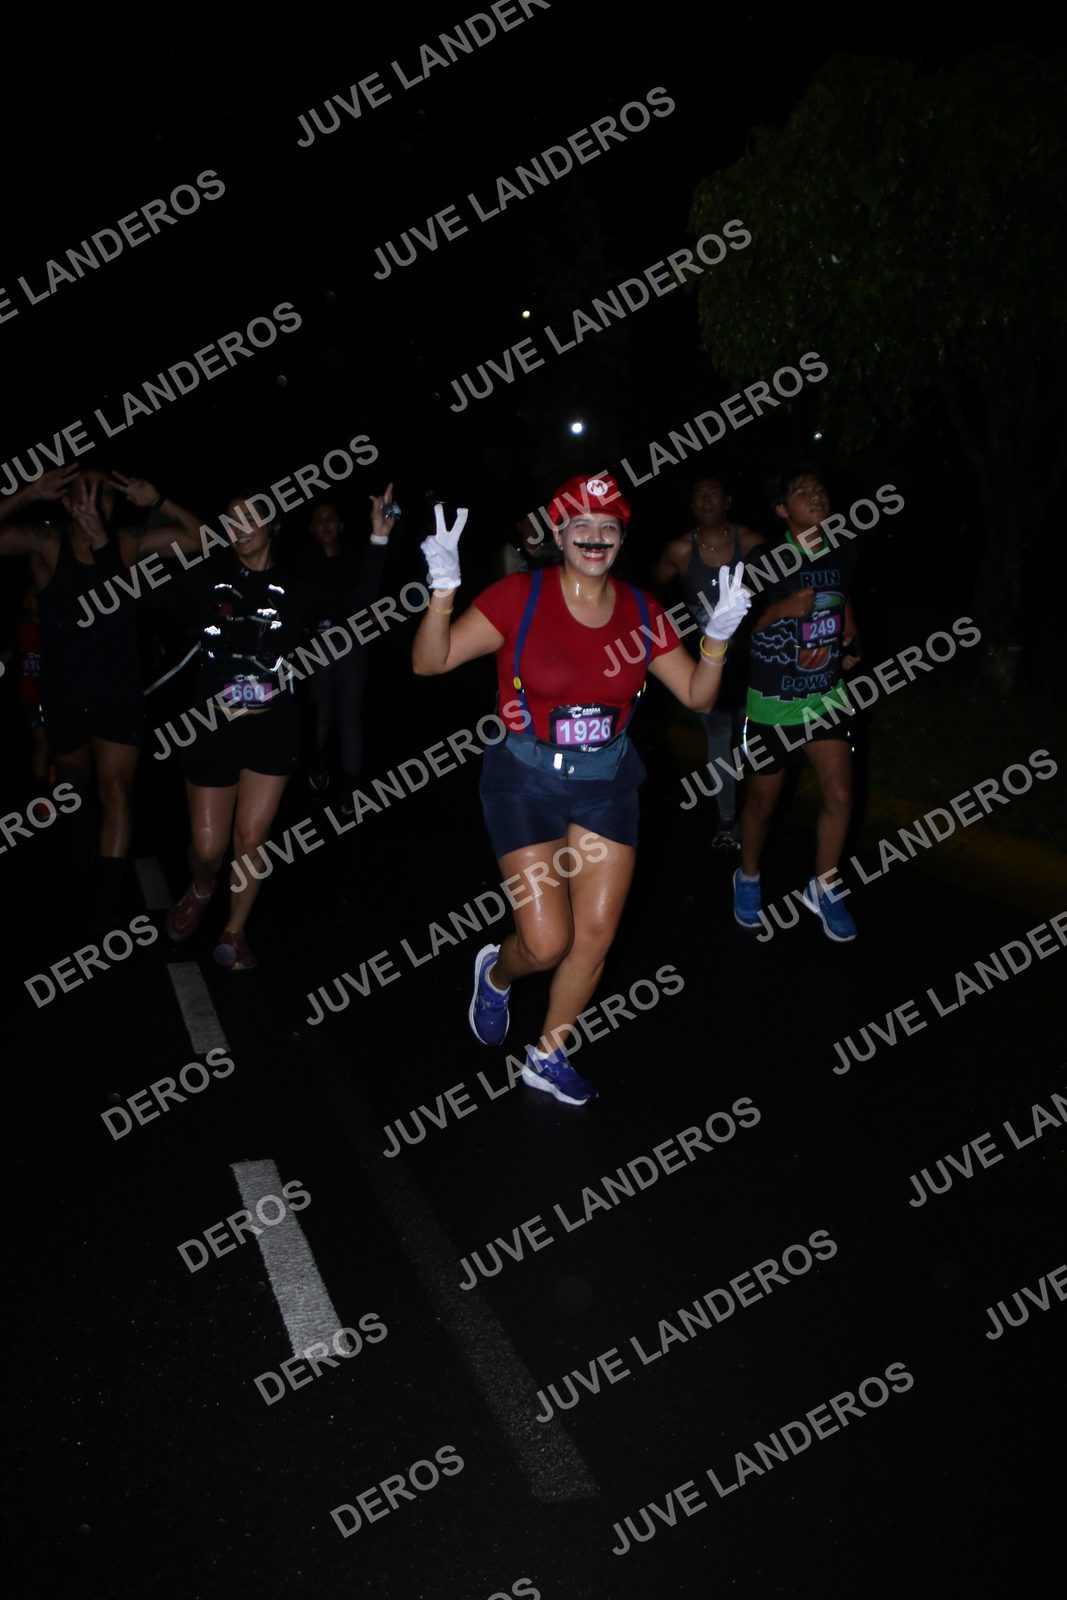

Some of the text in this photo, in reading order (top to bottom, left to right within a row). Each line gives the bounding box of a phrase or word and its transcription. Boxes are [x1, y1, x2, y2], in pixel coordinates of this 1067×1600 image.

[800, 567, 841, 588] RUN
[809, 617, 836, 639] 249
[231, 683, 265, 701] 660
[559, 717, 611, 743] 1926
